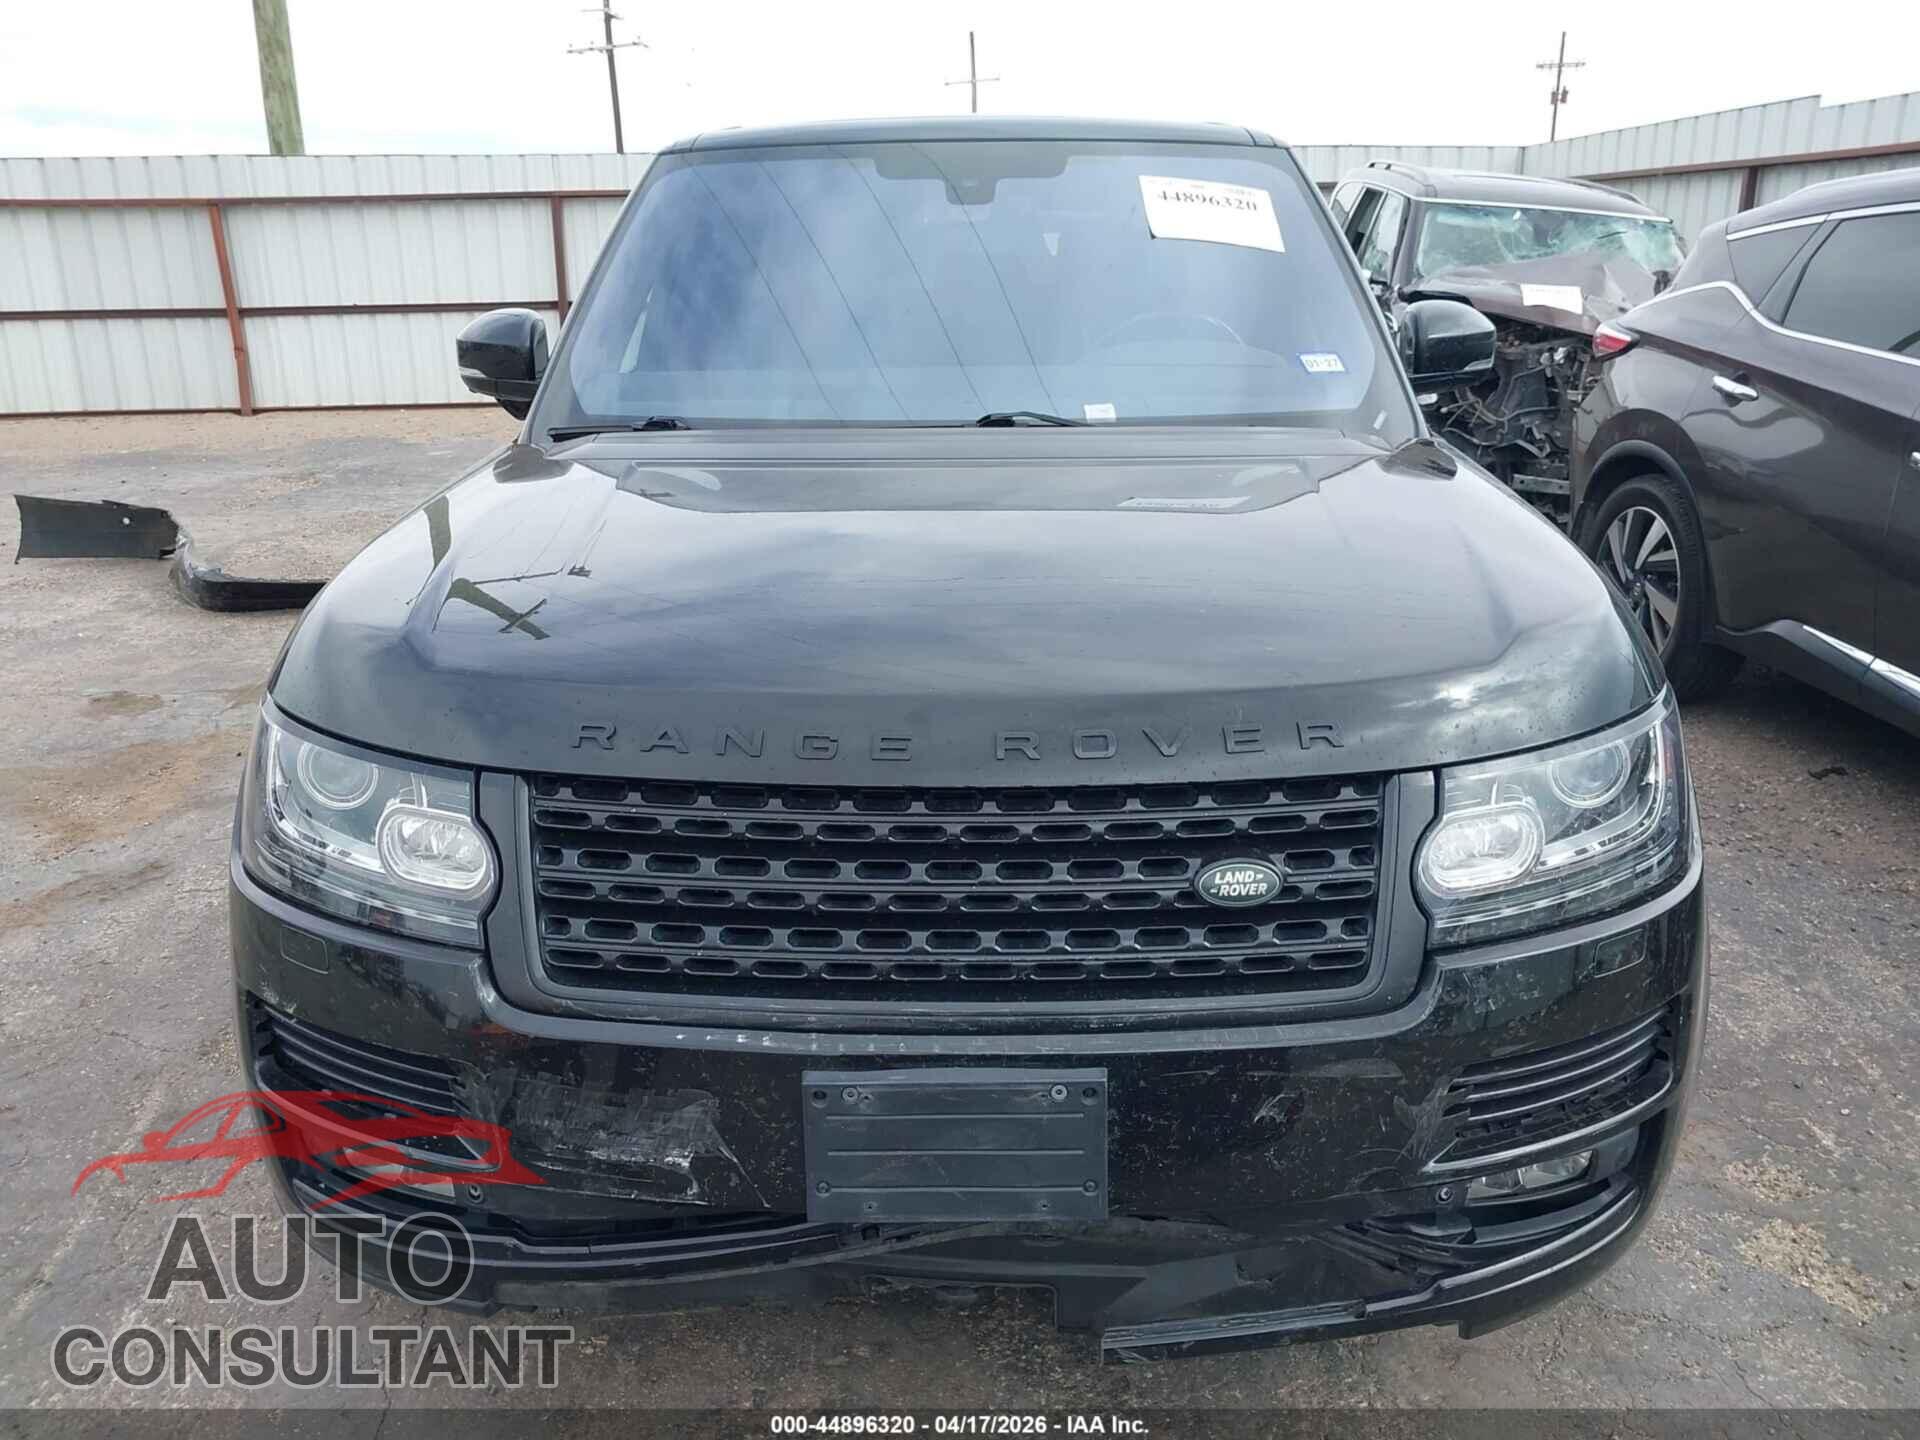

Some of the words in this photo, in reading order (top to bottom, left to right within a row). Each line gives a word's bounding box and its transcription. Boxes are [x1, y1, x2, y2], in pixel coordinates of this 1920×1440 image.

[1158, 189, 1258, 212] 44896320
[572, 720, 913, 761] RANGE
[994, 720, 1345, 760] ROVER
[1214, 870, 1255, 884] LAND
[1218, 883, 1268, 897] ROVER
